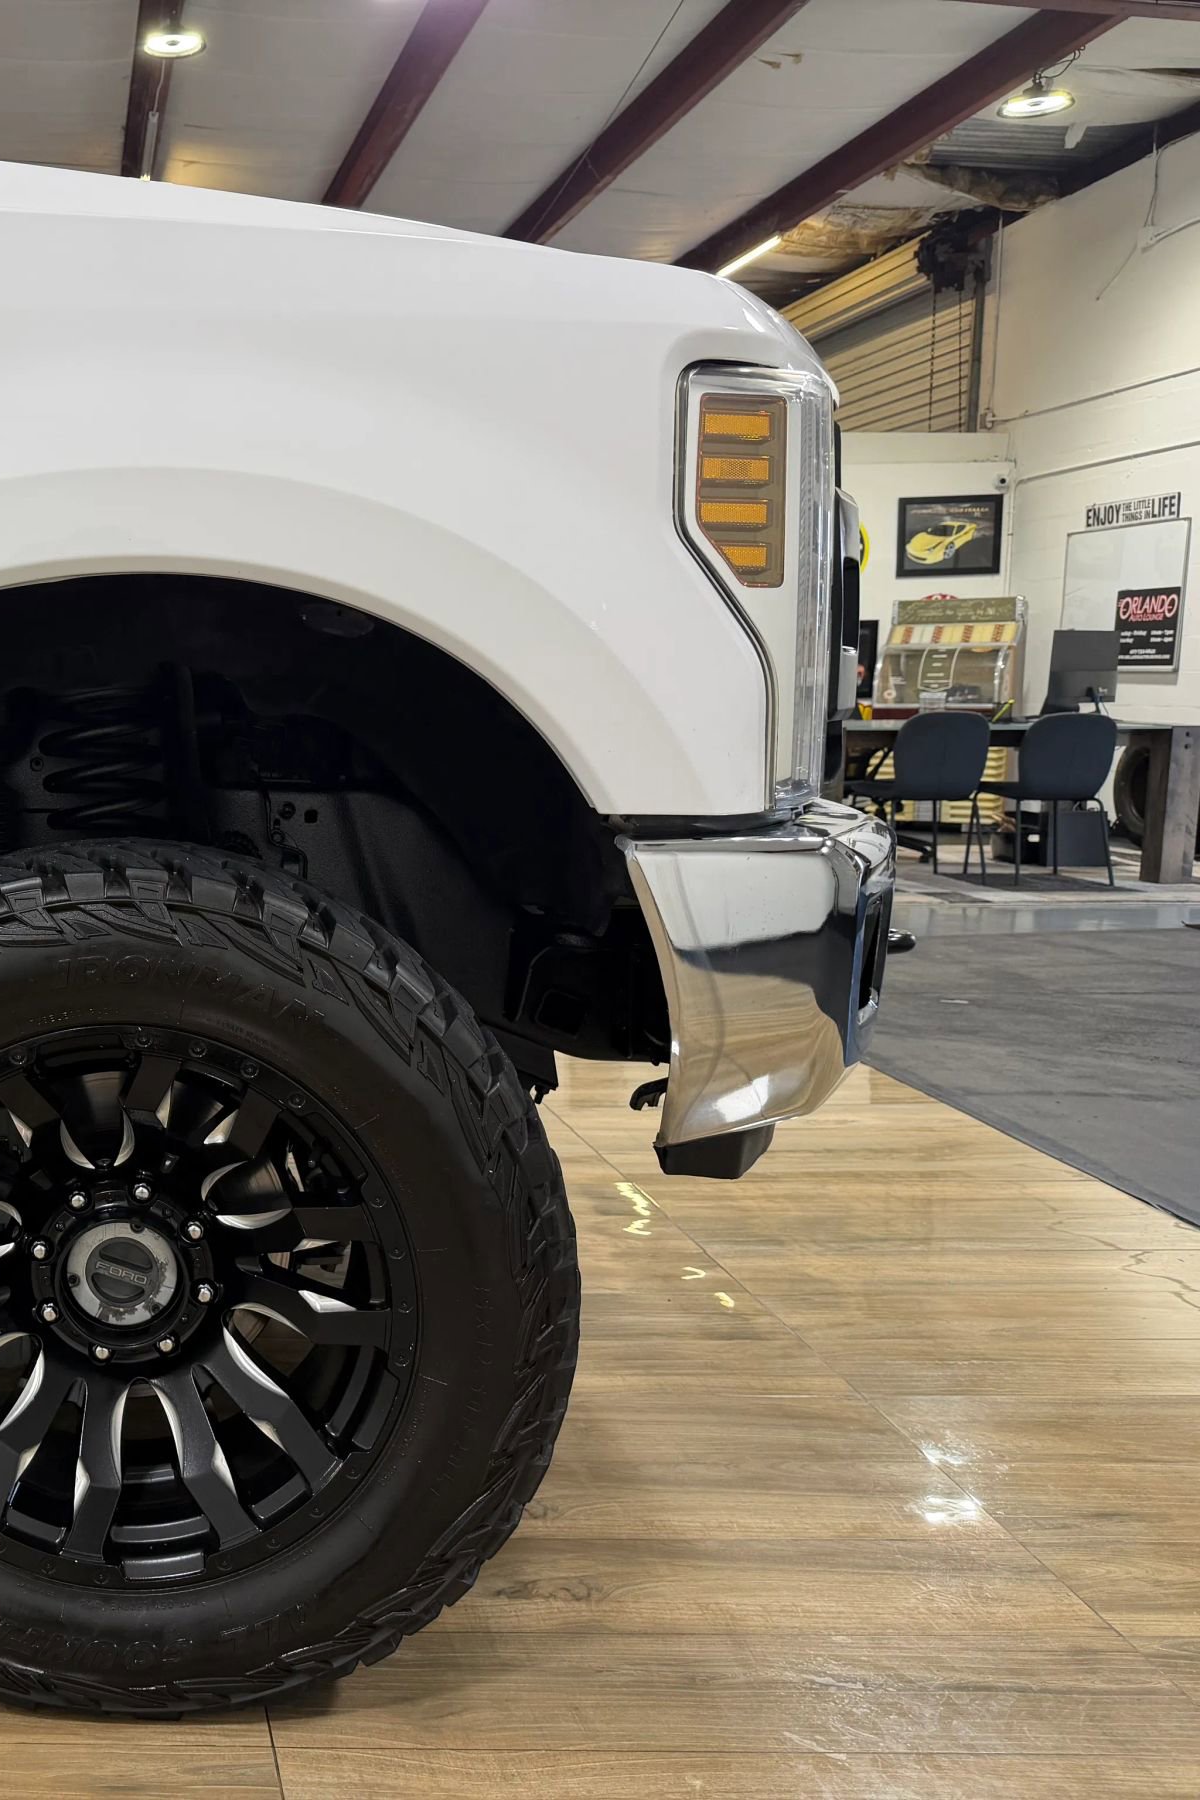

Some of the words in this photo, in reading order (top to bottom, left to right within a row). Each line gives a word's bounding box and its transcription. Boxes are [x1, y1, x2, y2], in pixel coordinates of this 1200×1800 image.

[1085, 504, 1121, 528] ENJOY
[1122, 503, 1133, 511] THE
[1133, 499, 1151, 509] LITTLE
[1122, 512, 1143, 522] THINGS
[1143, 509, 1151, 519] IN
[1120, 595, 1178, 619] ORLANDO
[95, 1261, 147, 1285] FORD
